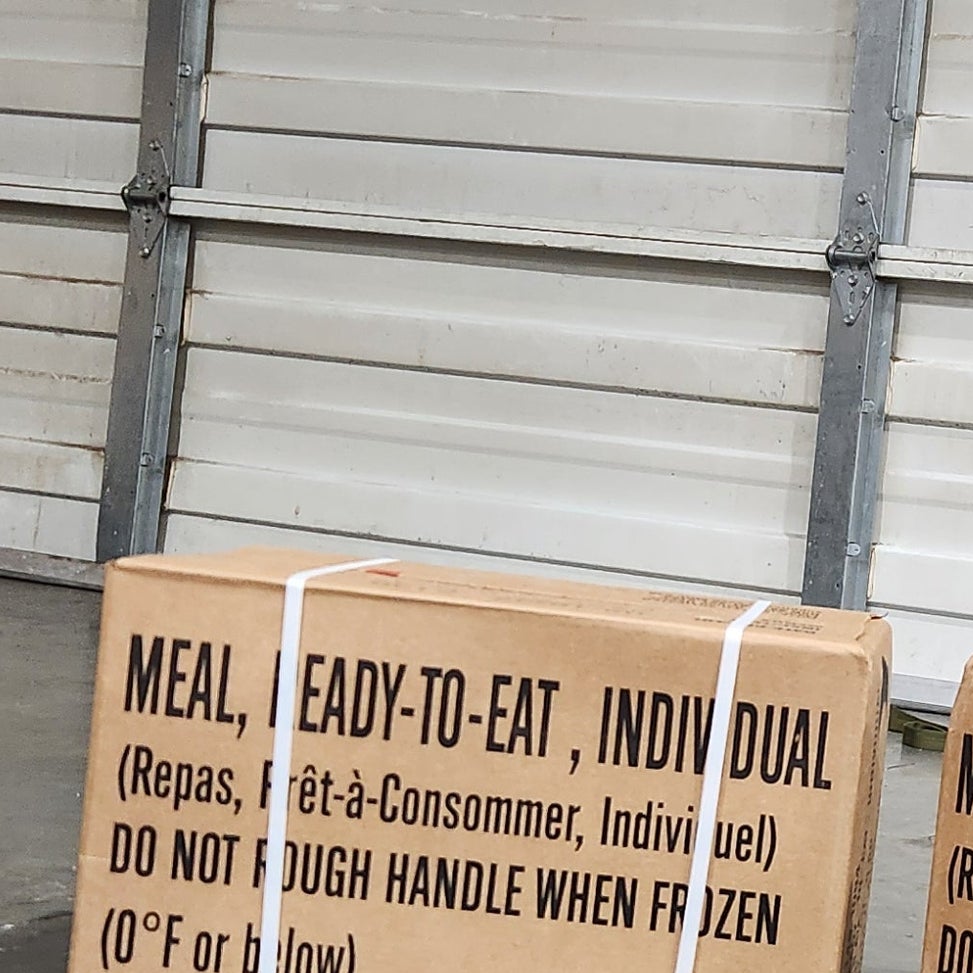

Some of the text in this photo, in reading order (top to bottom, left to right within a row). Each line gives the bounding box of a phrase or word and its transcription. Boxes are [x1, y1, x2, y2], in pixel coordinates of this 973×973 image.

[123, 634, 247, 739] MEAL,
[597, 686, 832, 790] INDIVDUAL
[117, 744, 242, 815] (Repas,
[600, 796, 777, 872] Indiviuel)
[109, 822, 157, 877] DO
[171, 829, 240, 885] NOT
[385, 852, 525, 917] HANDLE
[536, 866, 638, 928] WHEN
[193, 930, 230, 973] or
